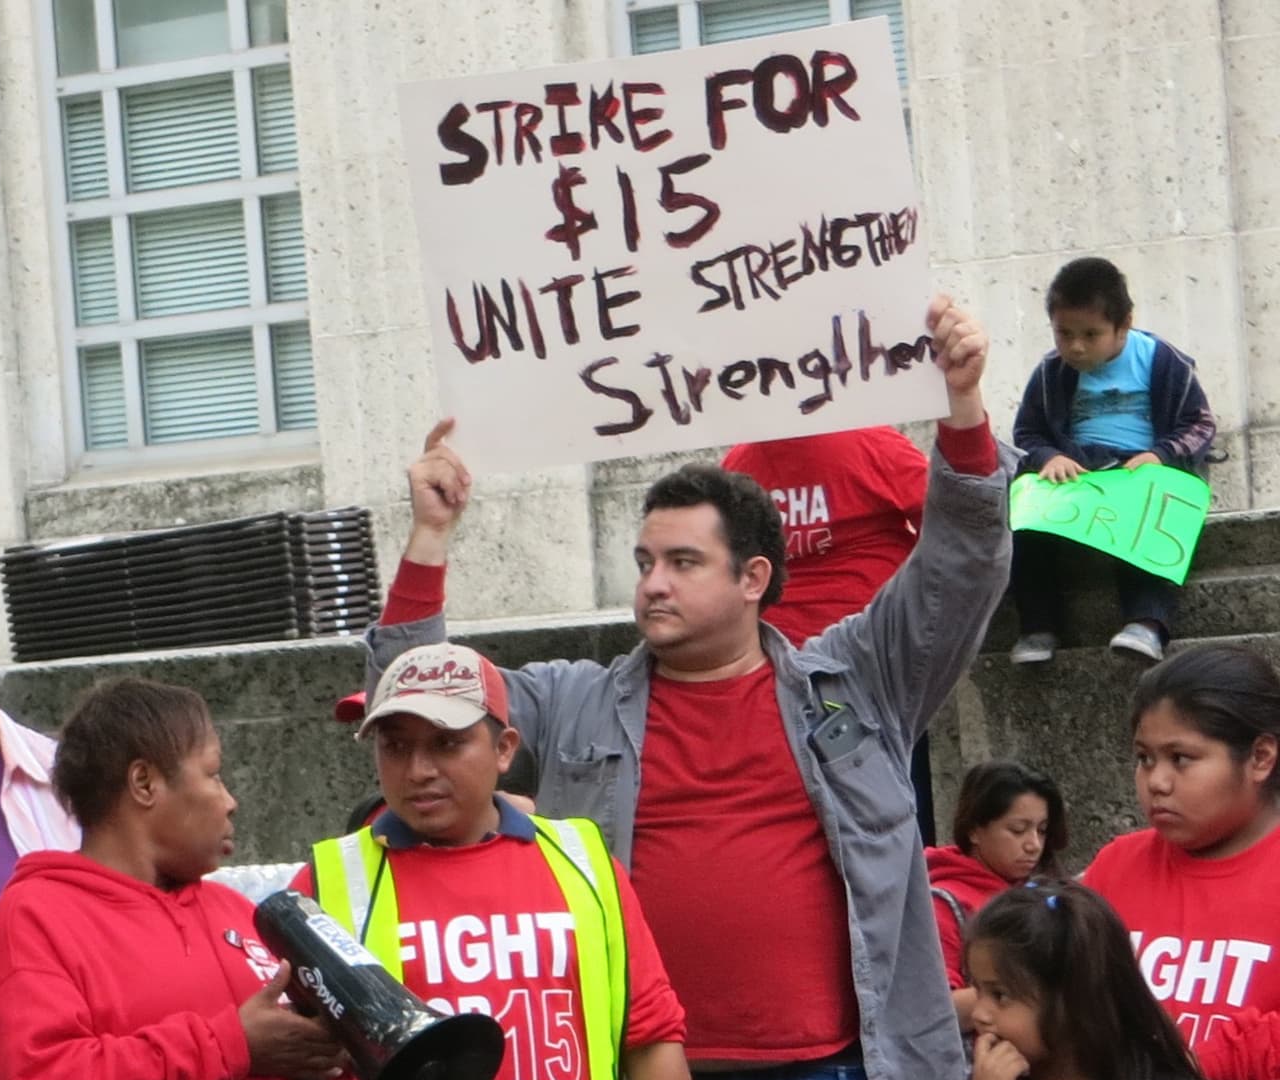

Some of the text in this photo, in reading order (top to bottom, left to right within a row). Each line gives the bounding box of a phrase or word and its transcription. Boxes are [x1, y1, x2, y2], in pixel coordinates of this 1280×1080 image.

[437, 50, 861, 187] STRIKE FOR
[545, 153, 722, 261] $15
[445, 265, 642, 365] UNITE
[1130, 480, 1202, 567] 15
